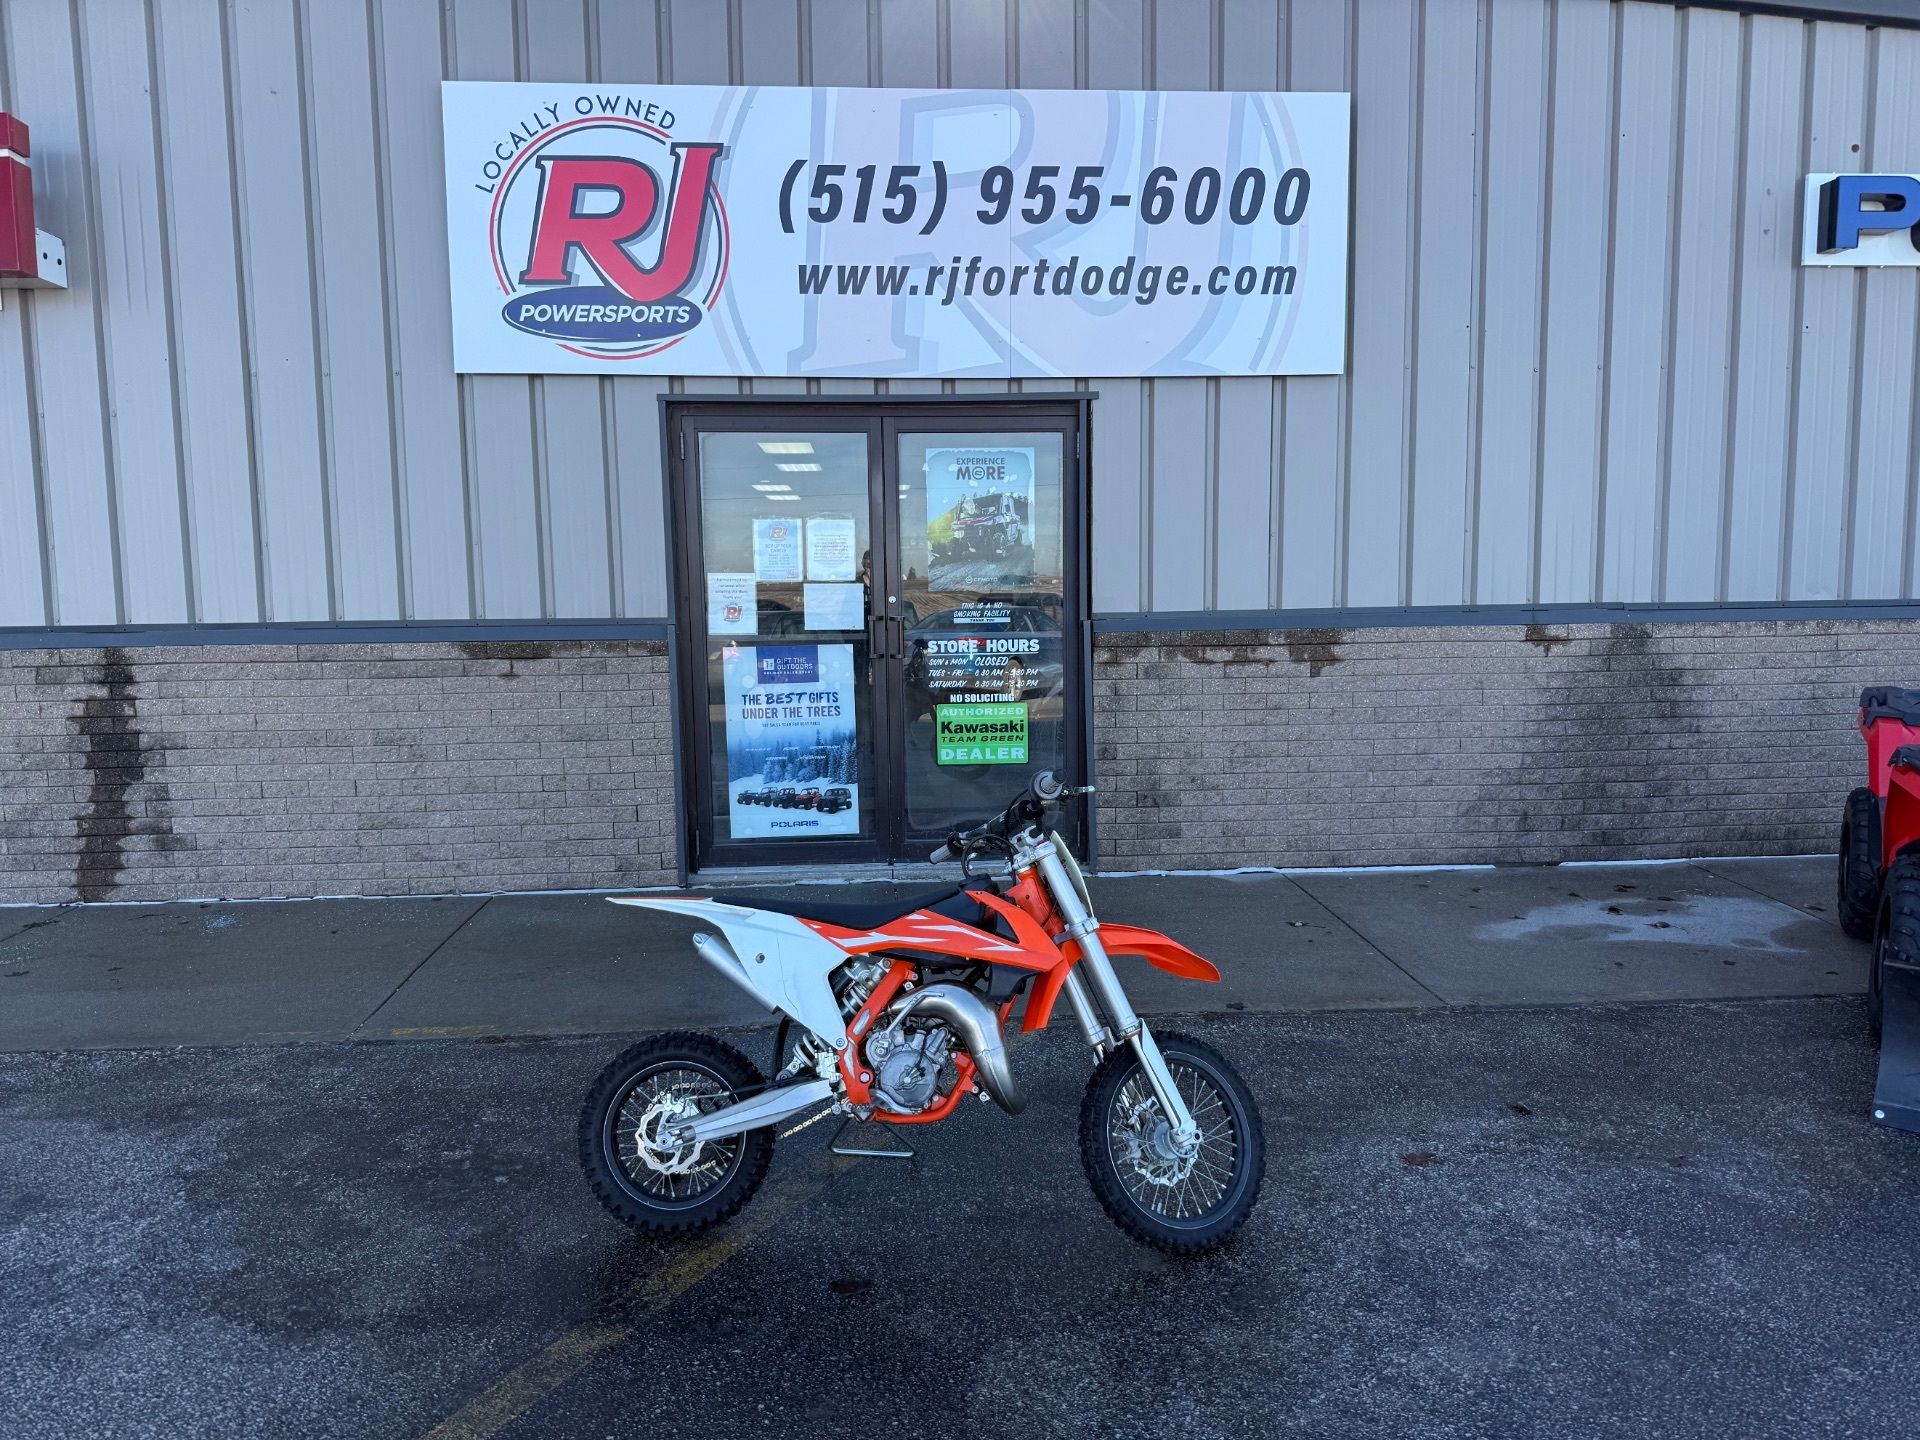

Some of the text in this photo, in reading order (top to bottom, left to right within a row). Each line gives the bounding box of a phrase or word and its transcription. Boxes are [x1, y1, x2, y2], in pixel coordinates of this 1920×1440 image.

[475, 94, 676, 194] LOCALLY OWNED
[778, 160, 1311, 235] (515) 955-6000
[1817, 175, 1920, 254] P
[518, 142, 725, 302] RJ
[798, 256, 1298, 306] www.rjfortdodge.com
[519, 304, 690, 324] POWERSPORTS
[956, 458, 1006, 466] EXPERIENCE
[956, 466, 1006, 480] MORE
[928, 639, 1040, 653] STORE HOURS
[928, 657, 945, 666] SUN
[950, 657, 968, 666] MON
[974, 656, 1009, 666] CLOSED
[928, 669, 946, 677] TUES
[742, 692, 838, 705] THE BEST GIFTS
[950, 693, 1015, 703] NO SOLICITING
[742, 705, 841, 719] UNDER THE TREES
[941, 708, 1024, 716] AUTHORIZED
[941, 720, 1024, 734] Kawasaki
[941, 747, 1024, 760] DEALER
